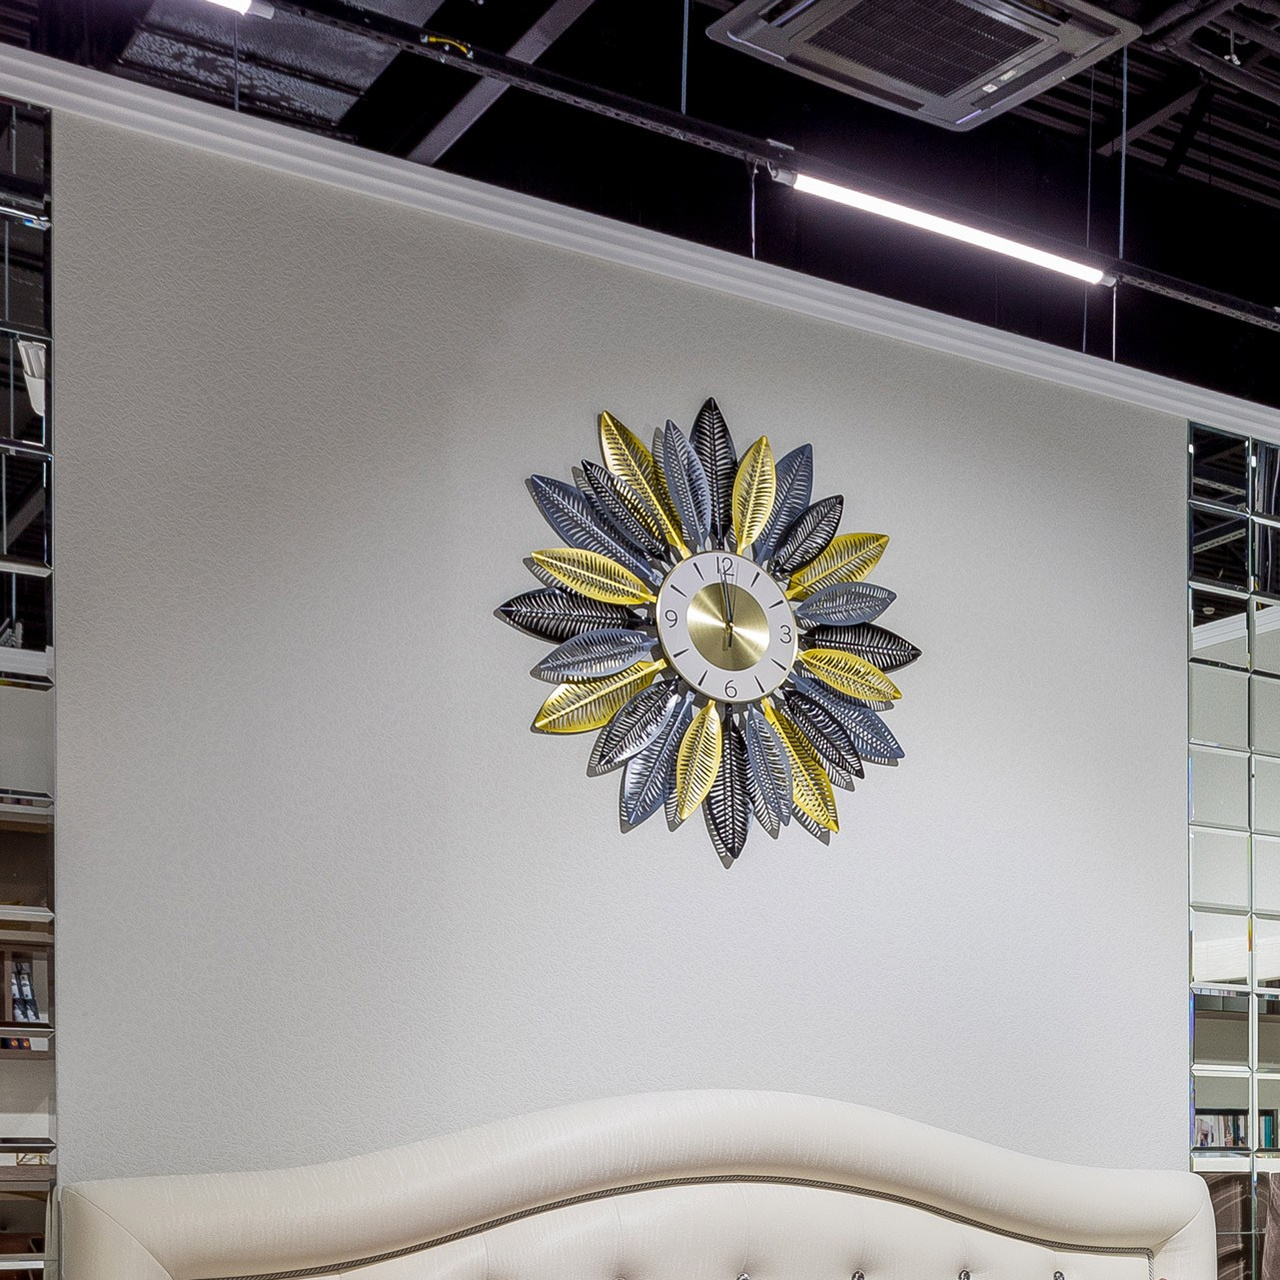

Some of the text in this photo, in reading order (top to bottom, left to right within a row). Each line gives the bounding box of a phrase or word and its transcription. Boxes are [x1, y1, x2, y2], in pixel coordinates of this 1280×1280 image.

[716, 556, 735, 577] 12
[664, 609, 678, 628] 9
[779, 625, 792, 644] 3
[724, 679, 738, 698] 6
